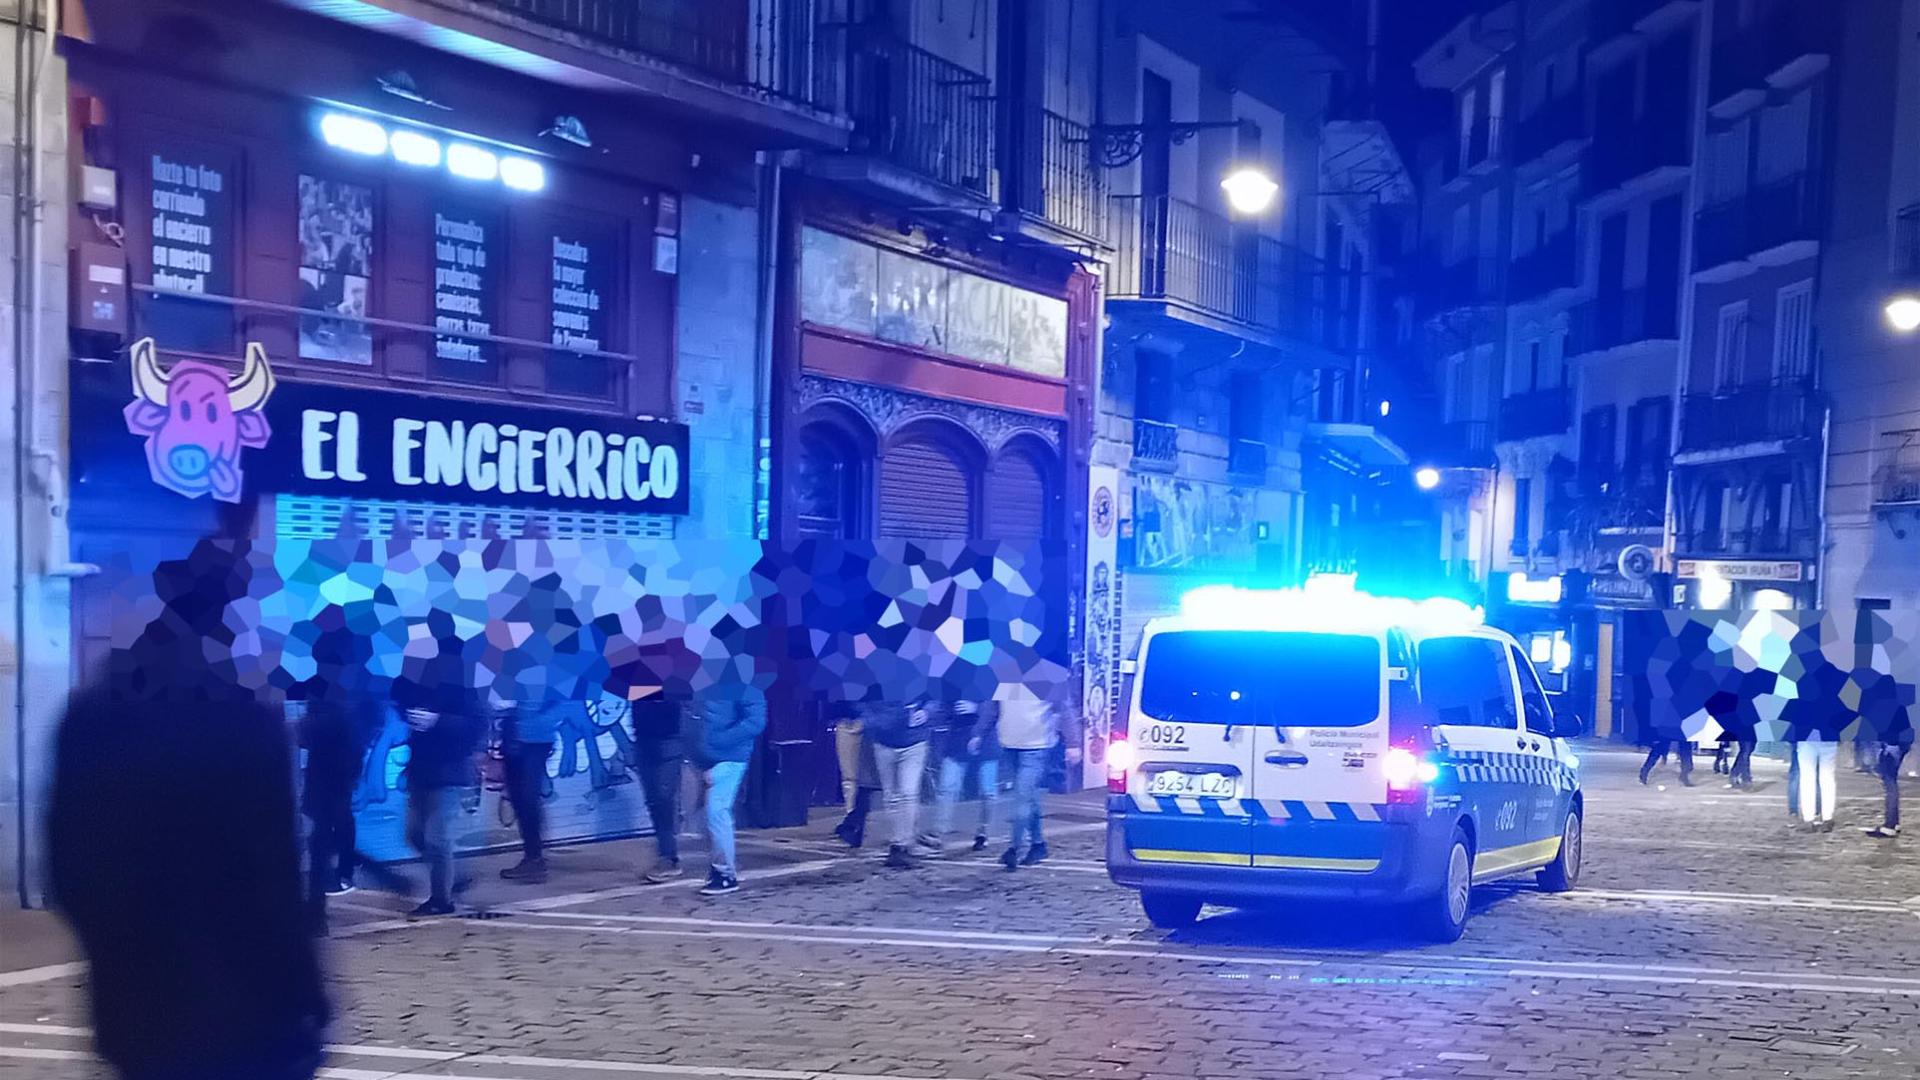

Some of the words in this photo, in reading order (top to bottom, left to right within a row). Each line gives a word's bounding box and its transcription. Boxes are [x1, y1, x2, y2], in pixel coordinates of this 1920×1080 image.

[199, 164, 222, 192] foto
[152, 188, 205, 217] corriendo
[152, 212, 164, 238] el
[165, 217, 211, 246] encierro
[152, 245, 167, 266] en
[168, 248, 211, 273] nuestro
[436, 240, 456, 263] todo
[457, 243, 474, 270] tipo
[474, 246, 487, 268] de
[301, 408, 367, 482] EL
[1151, 725, 1185, 744] 092
